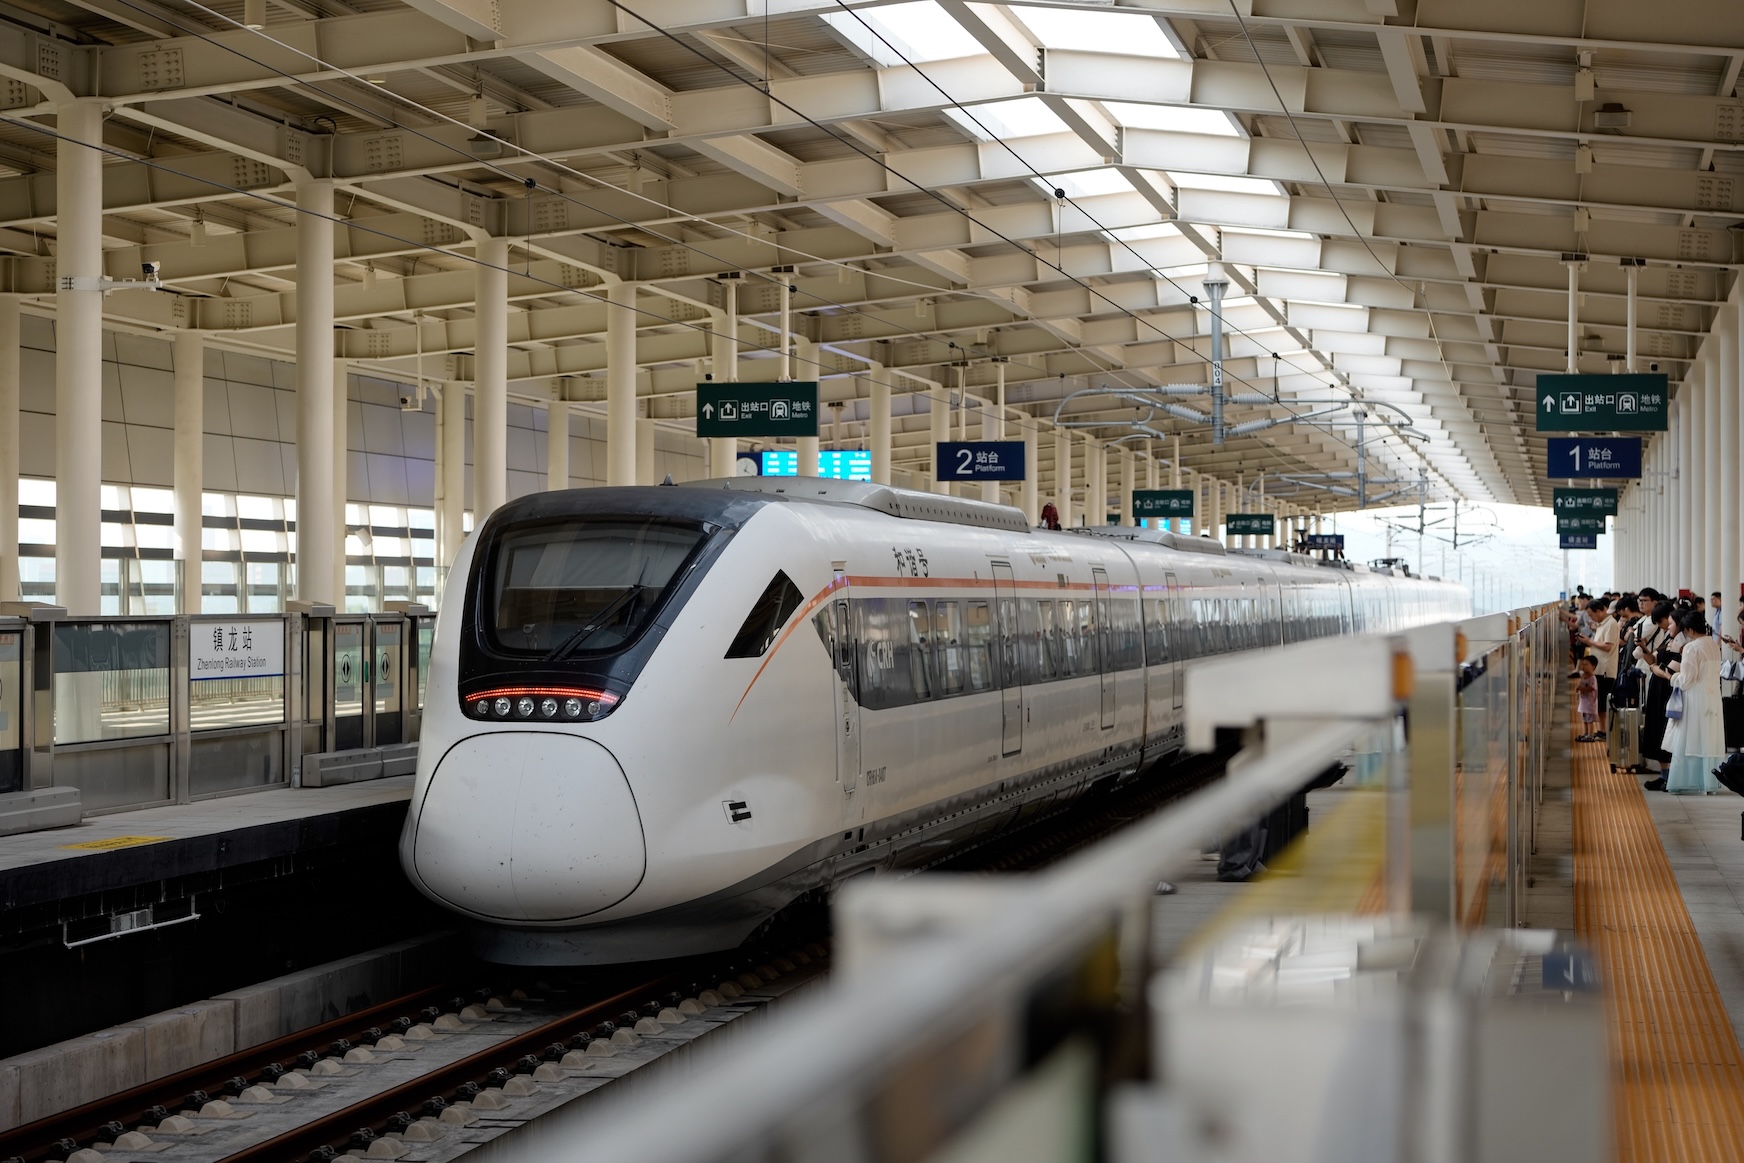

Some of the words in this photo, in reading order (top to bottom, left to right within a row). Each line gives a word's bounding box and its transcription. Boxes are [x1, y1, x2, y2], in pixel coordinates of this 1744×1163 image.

[741, 401, 768, 412] 出站口
[792, 401, 811, 411] 地铁
[1584, 394, 1615, 405] 出站口
[1640, 394, 1662, 404] 地铁
[955, 449, 974, 475] 2
[976, 451, 1000, 464] 站台
[974, 464, 1006, 473] Platform
[1569, 445, 1580, 471] 1
[1588, 447, 1613, 461] 站台
[1588, 461, 1621, 469] Platform
[892, 546, 929, 578] 和谐号
[213, 626, 252, 651] 镇龙站
[197, 658, 224, 672] Zhenlong
[224, 656, 247, 671] Railway
[247, 655, 267, 668] Station
[877, 641, 895, 669] CRH
